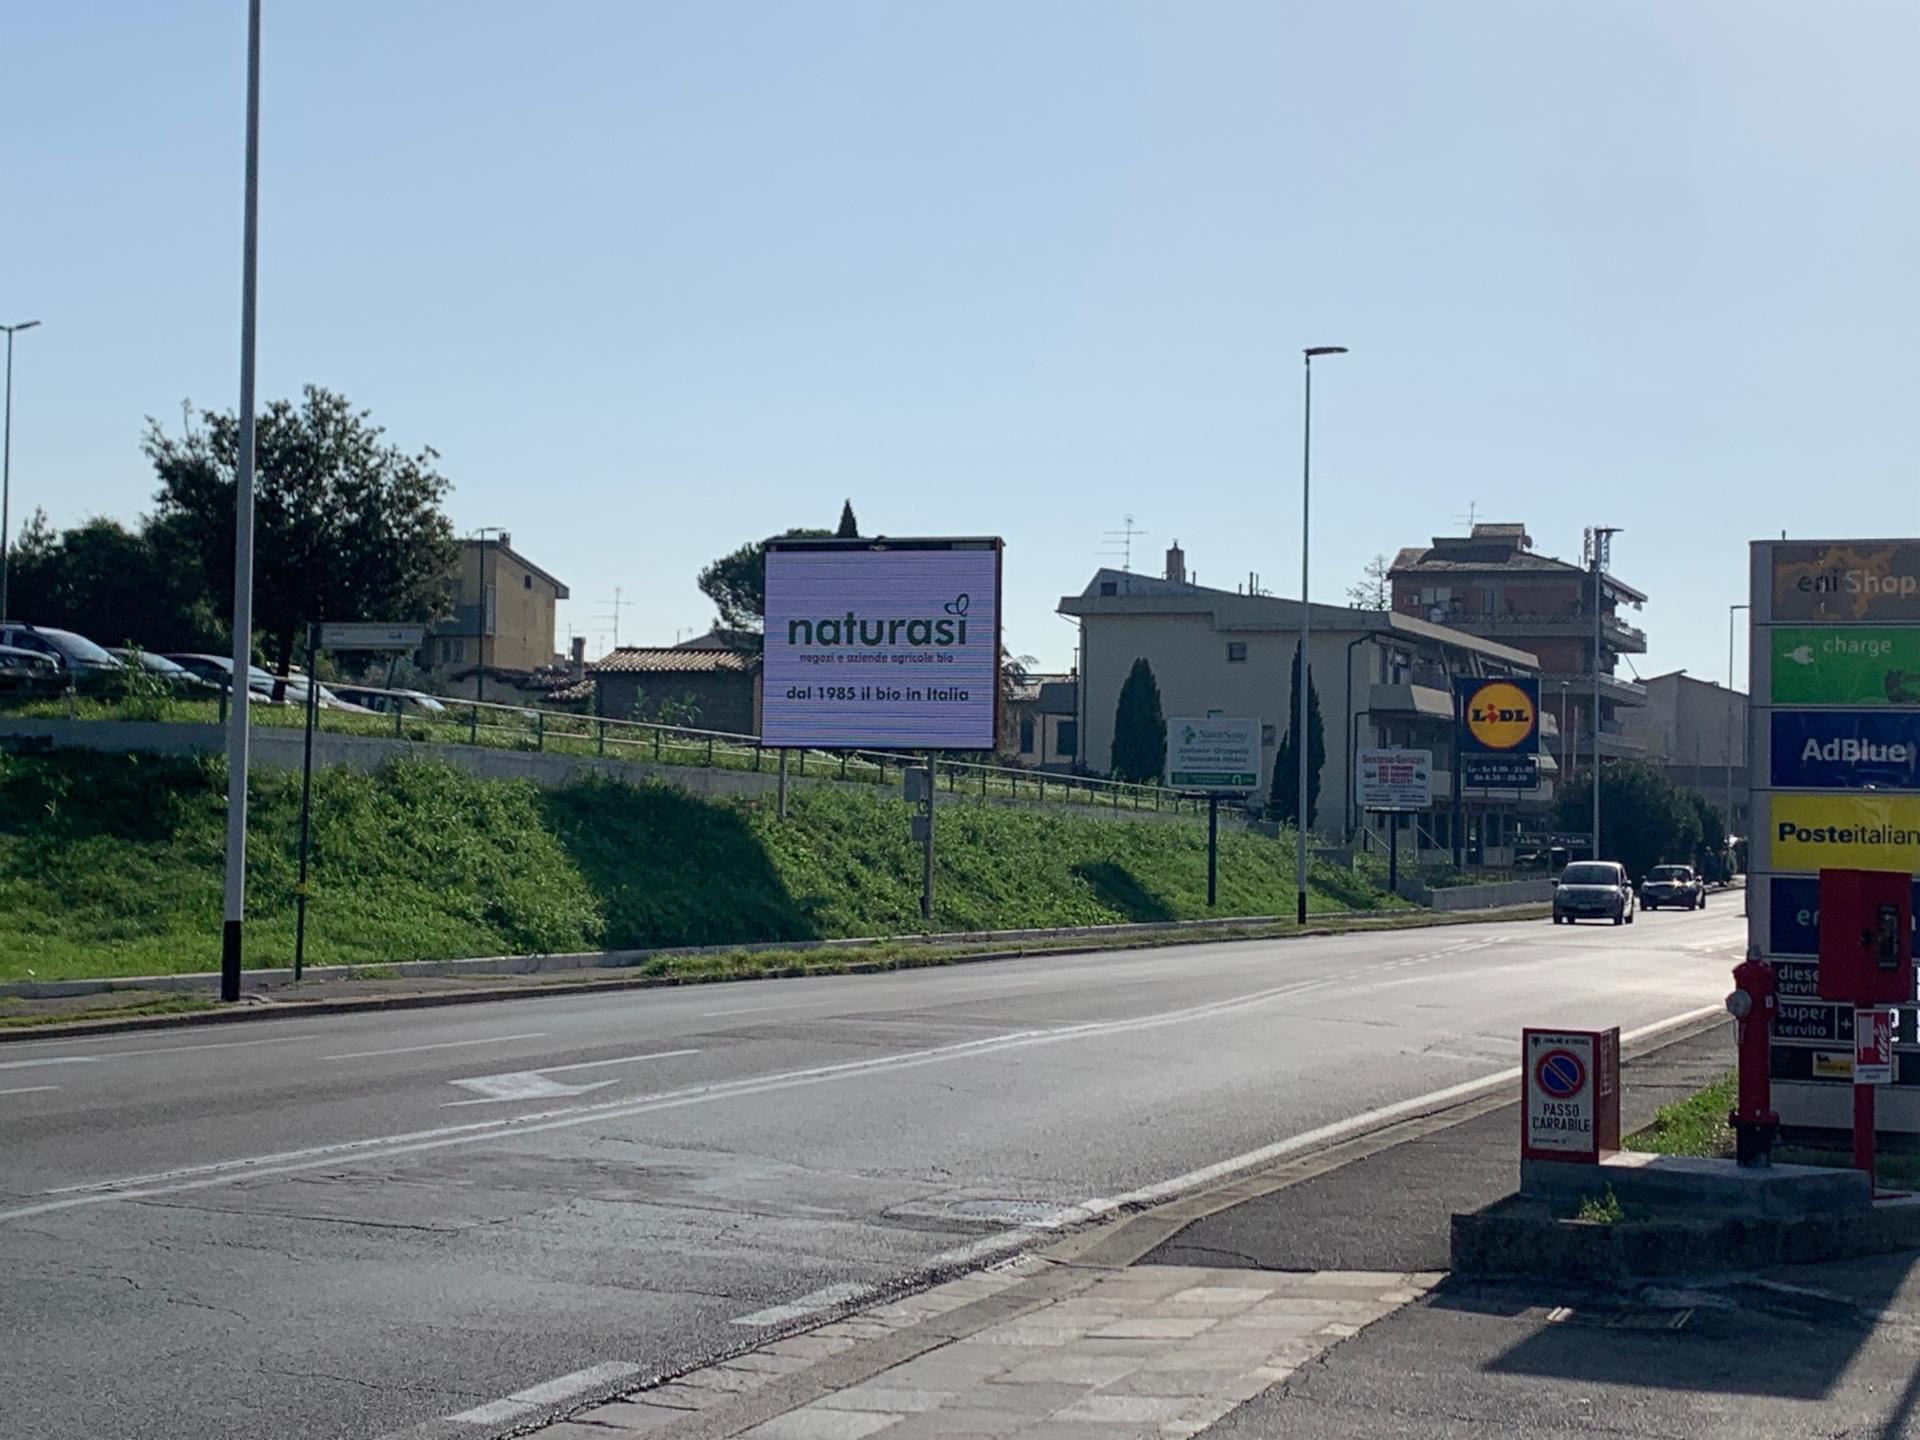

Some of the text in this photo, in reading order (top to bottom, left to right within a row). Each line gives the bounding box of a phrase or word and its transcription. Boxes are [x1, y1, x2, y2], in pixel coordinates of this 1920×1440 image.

[1844, 570, 1917, 598] Shop
[1822, 636, 1892, 657] charge
[799, 652, 954, 664] negozi e aziende agricole bio
[786, 686, 969, 701] dal 1985 il bio in Italia
[1801, 738, 1906, 762] AdBlue
[1778, 822, 1920, 844] Posteitalian
[1778, 964, 1819, 981] diese
[1778, 1007, 1828, 1021] super
[1778, 1024, 1827, 1037] servito
[1543, 1102, 1580, 1117] PASSO
[1532, 1116, 1591, 1132] CARRABILE
